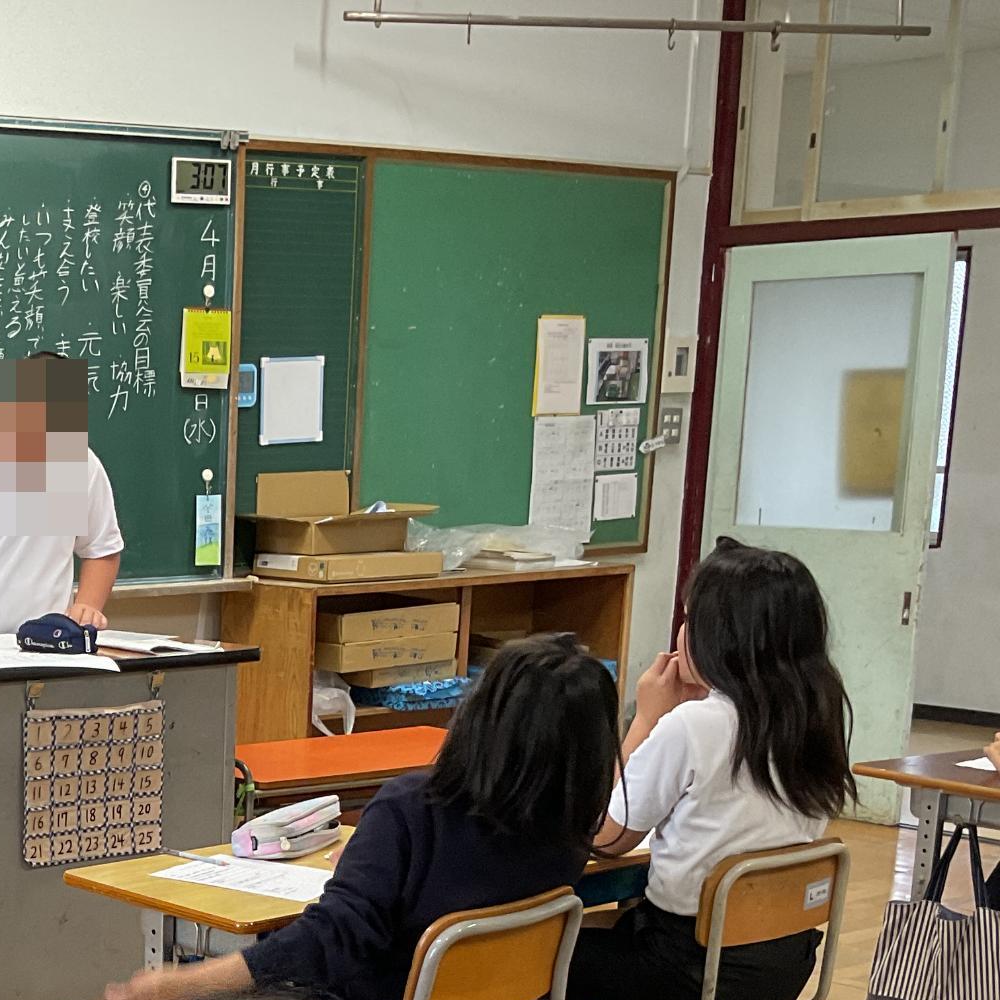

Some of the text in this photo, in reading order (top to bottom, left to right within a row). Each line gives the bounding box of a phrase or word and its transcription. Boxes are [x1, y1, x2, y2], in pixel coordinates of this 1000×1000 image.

[92, 722, 101, 738] 3
[120, 718, 127, 734] 4
[146, 718, 153, 732] 5
[34, 746, 154, 770] 6 7 8 9 10
[32, 784, 41, 800] 11
[86, 781, 97, 794] 13
[112, 777, 125, 790] 14
[140, 774, 151, 789] 15
[32, 804, 151, 830] 16 17 18 19 20
[30, 831, 153, 859] 21 22 23 24 25
